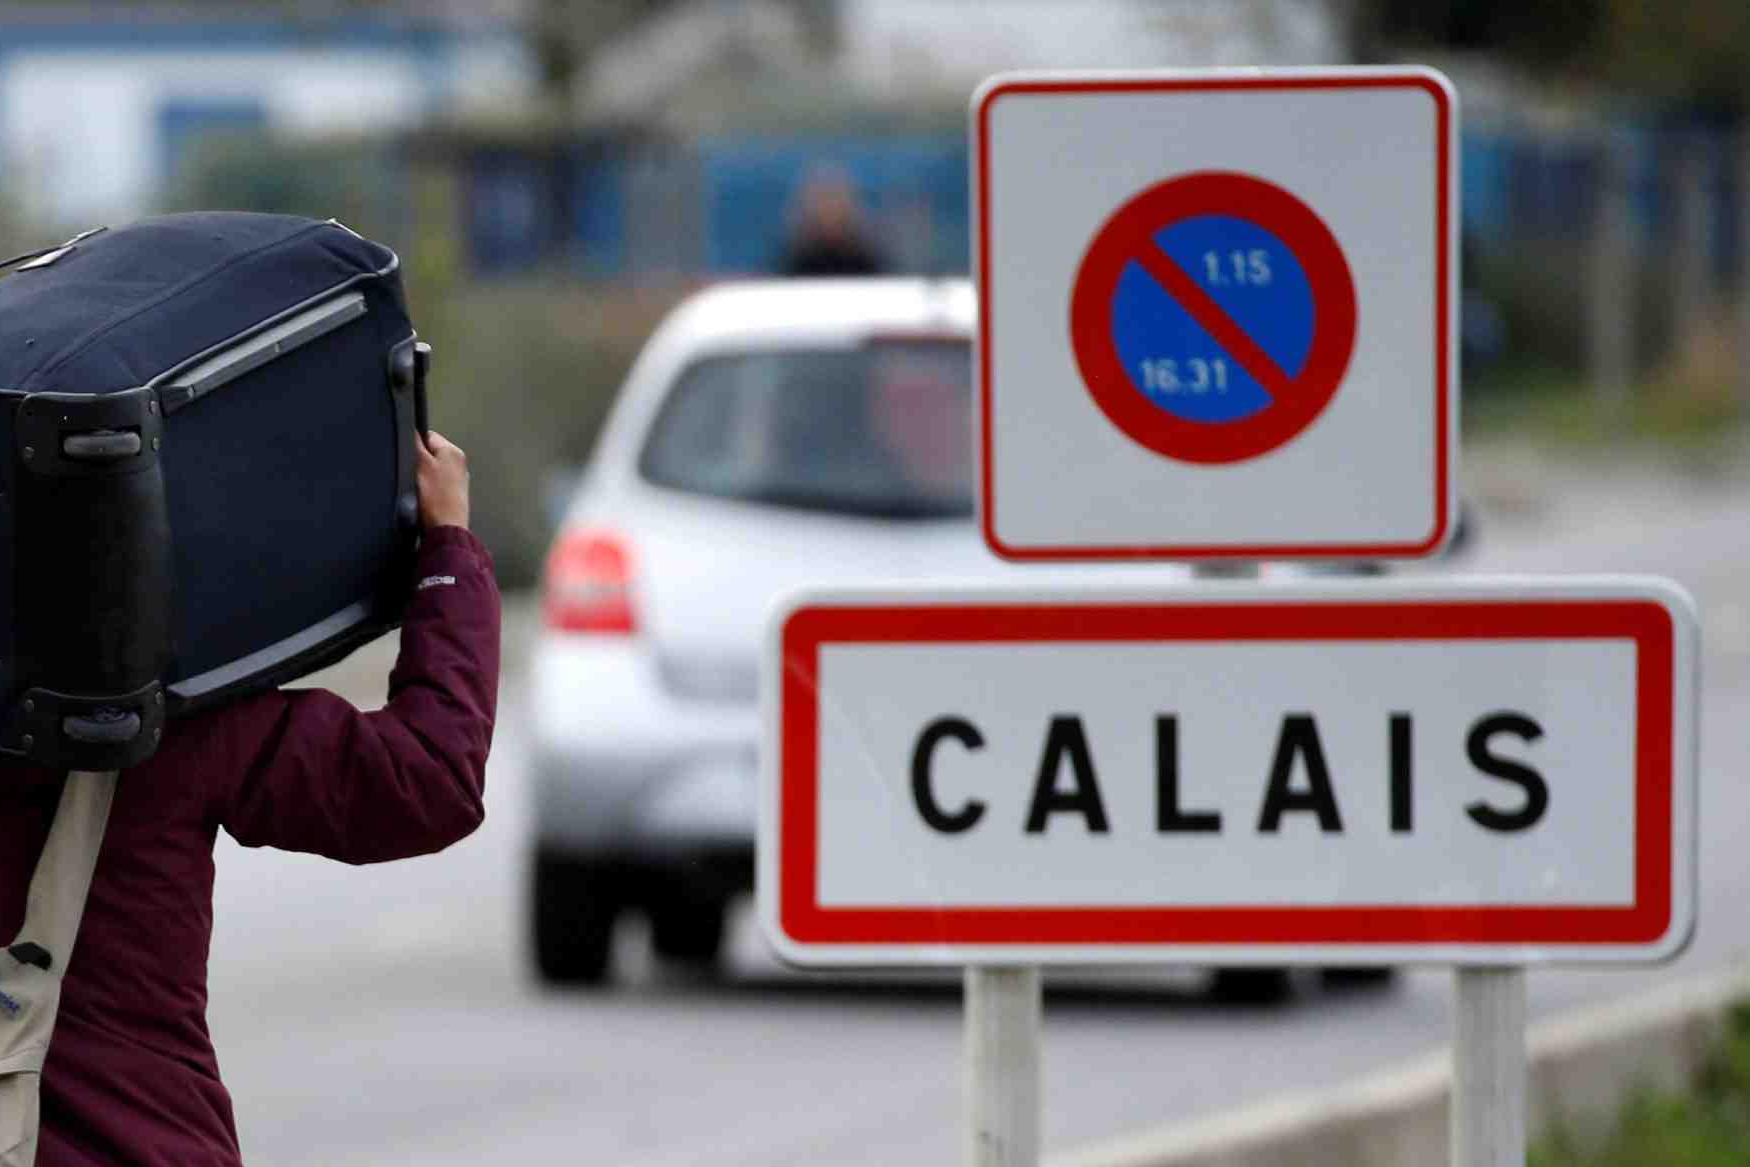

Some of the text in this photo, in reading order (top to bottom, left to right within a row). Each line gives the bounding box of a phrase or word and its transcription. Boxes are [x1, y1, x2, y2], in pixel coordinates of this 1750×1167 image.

[1203, 249, 1272, 287] 1.15
[1140, 356, 1228, 395] 16.31
[909, 711, 1551, 836] CALAIS
